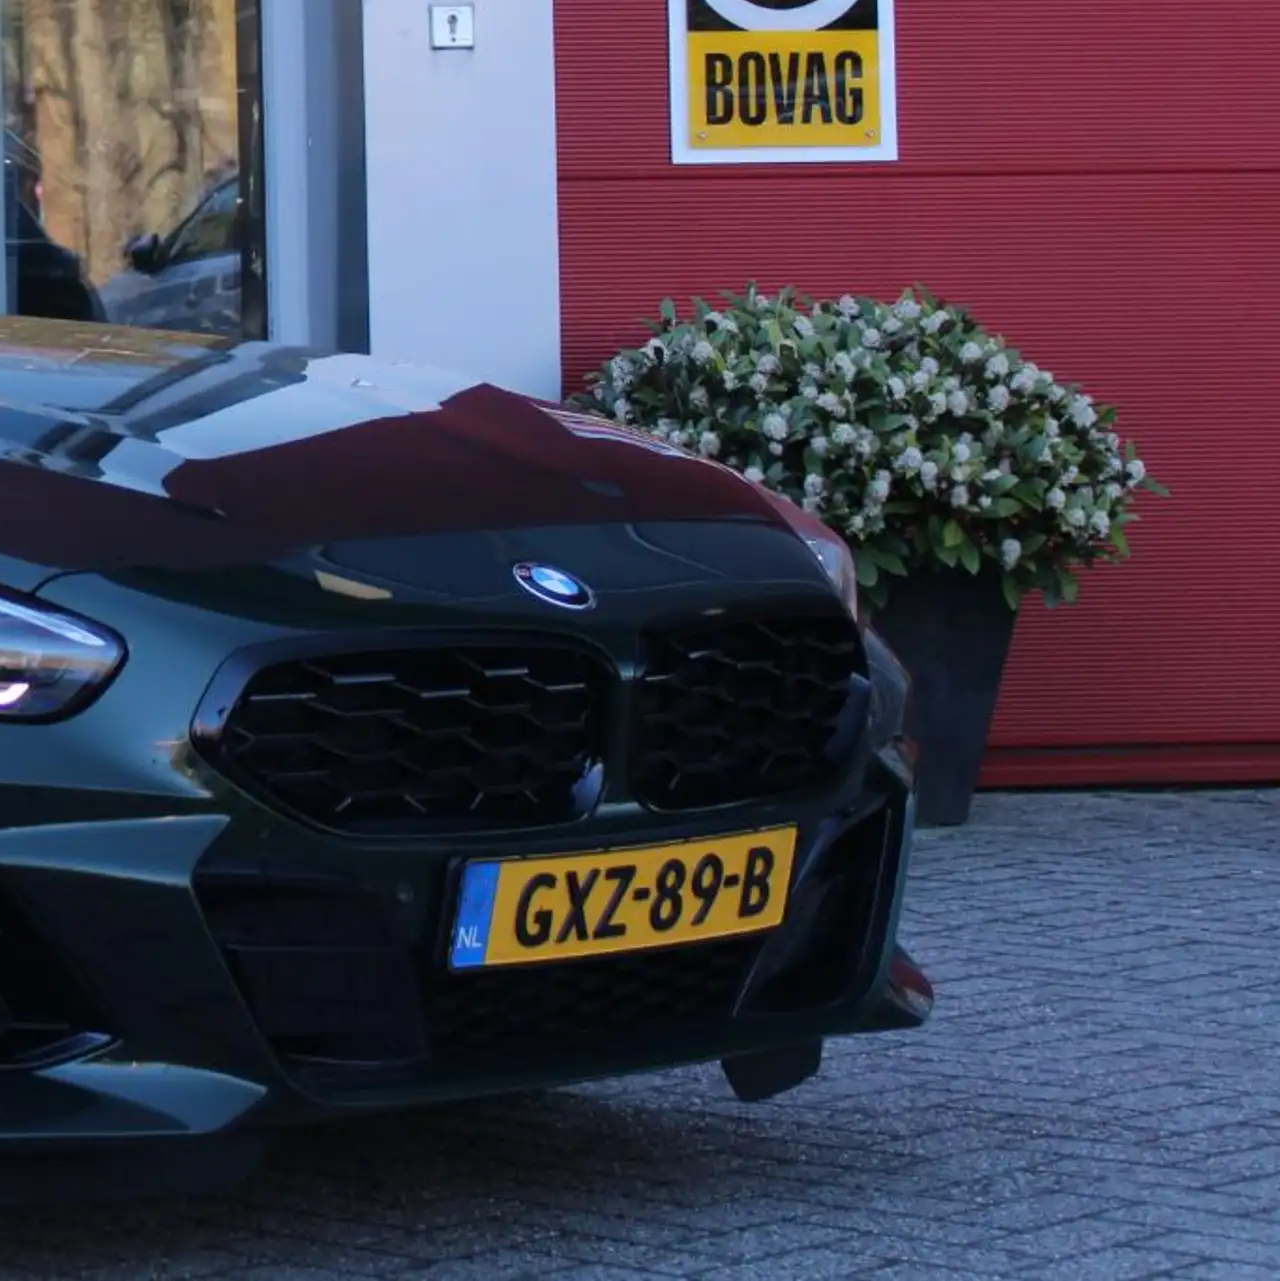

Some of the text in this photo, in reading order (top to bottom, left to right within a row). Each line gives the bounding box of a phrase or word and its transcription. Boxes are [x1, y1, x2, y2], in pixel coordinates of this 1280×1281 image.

[704, 51, 864, 126] BOVAG
[457, 845, 776, 950] NL GXZ-89-B
